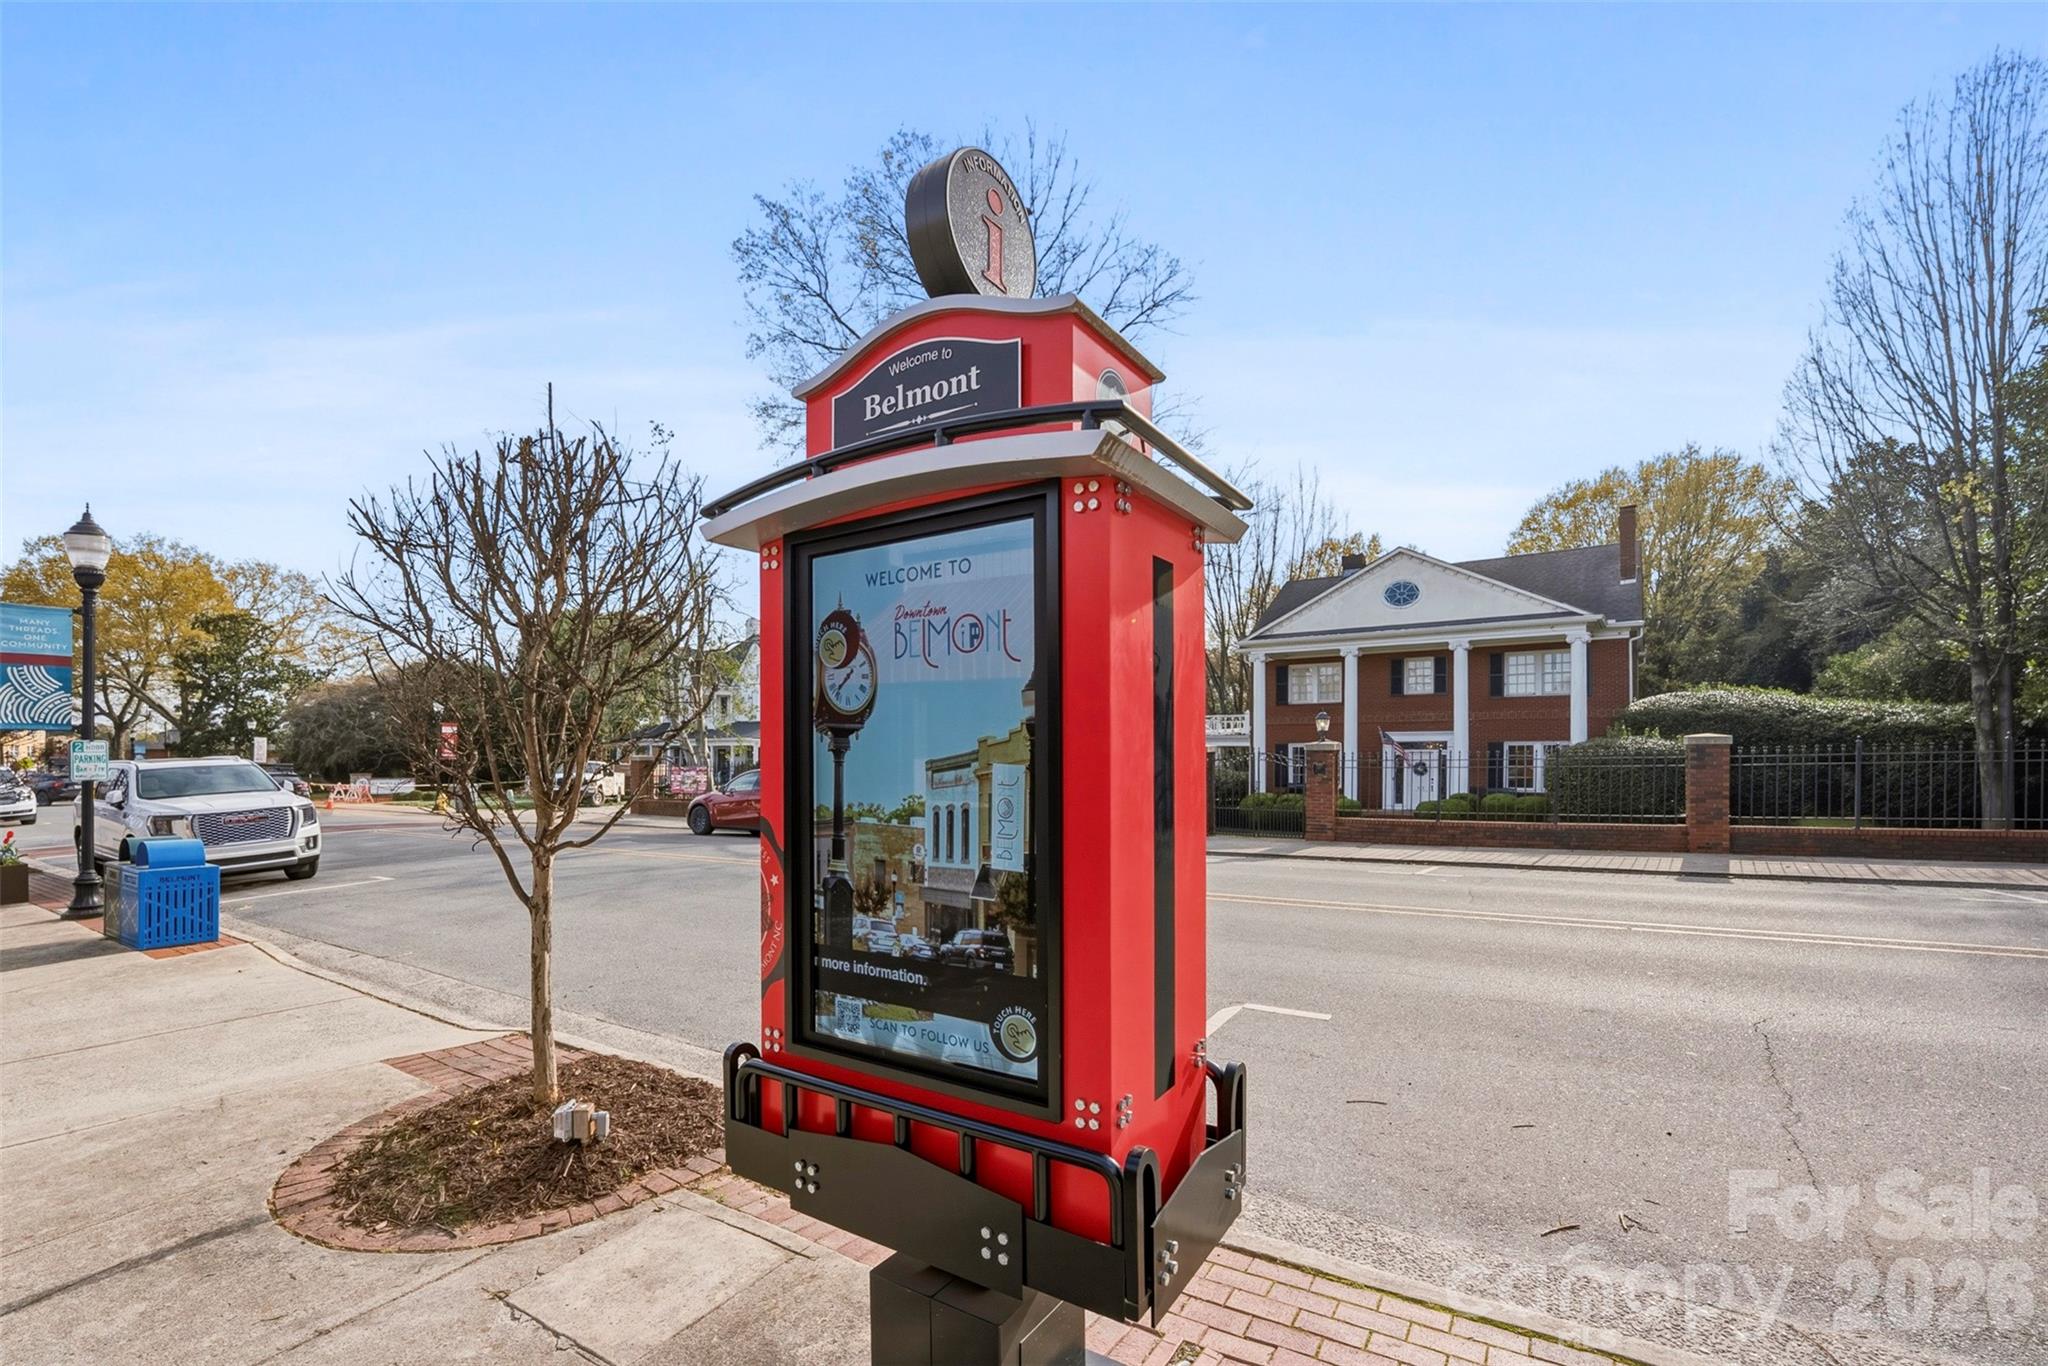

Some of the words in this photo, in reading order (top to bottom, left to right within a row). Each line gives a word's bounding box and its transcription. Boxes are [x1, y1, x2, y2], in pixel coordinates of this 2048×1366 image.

[963, 156, 1025, 224] INFORMATION
[888, 353, 939, 377] Welcome
[941, 346, 953, 359] to
[863, 365, 981, 421] Belmont
[865, 563, 942, 587] WELCOME
[949, 558, 972, 576] TO
[19, 618, 50, 626] MANY
[895, 601, 948, 621] Downtown
[1, 640, 68, 650] COMMUNITY
[74, 742, 82, 752] 2
[74, 754, 106, 764] PARKING
[773, 920, 783, 941] NC
[821, 957, 850, 972] more
[853, 960, 928, 986] information.
[993, 1006, 1013, 1034] TOUCH
[1014, 1006, 1037, 1024] HERE
[870, 1019, 897, 1033] SCAN
[902, 1024, 917, 1038] TO
[921, 1028, 969, 1049] FOLLOW
[974, 1038, 990, 1054] US
